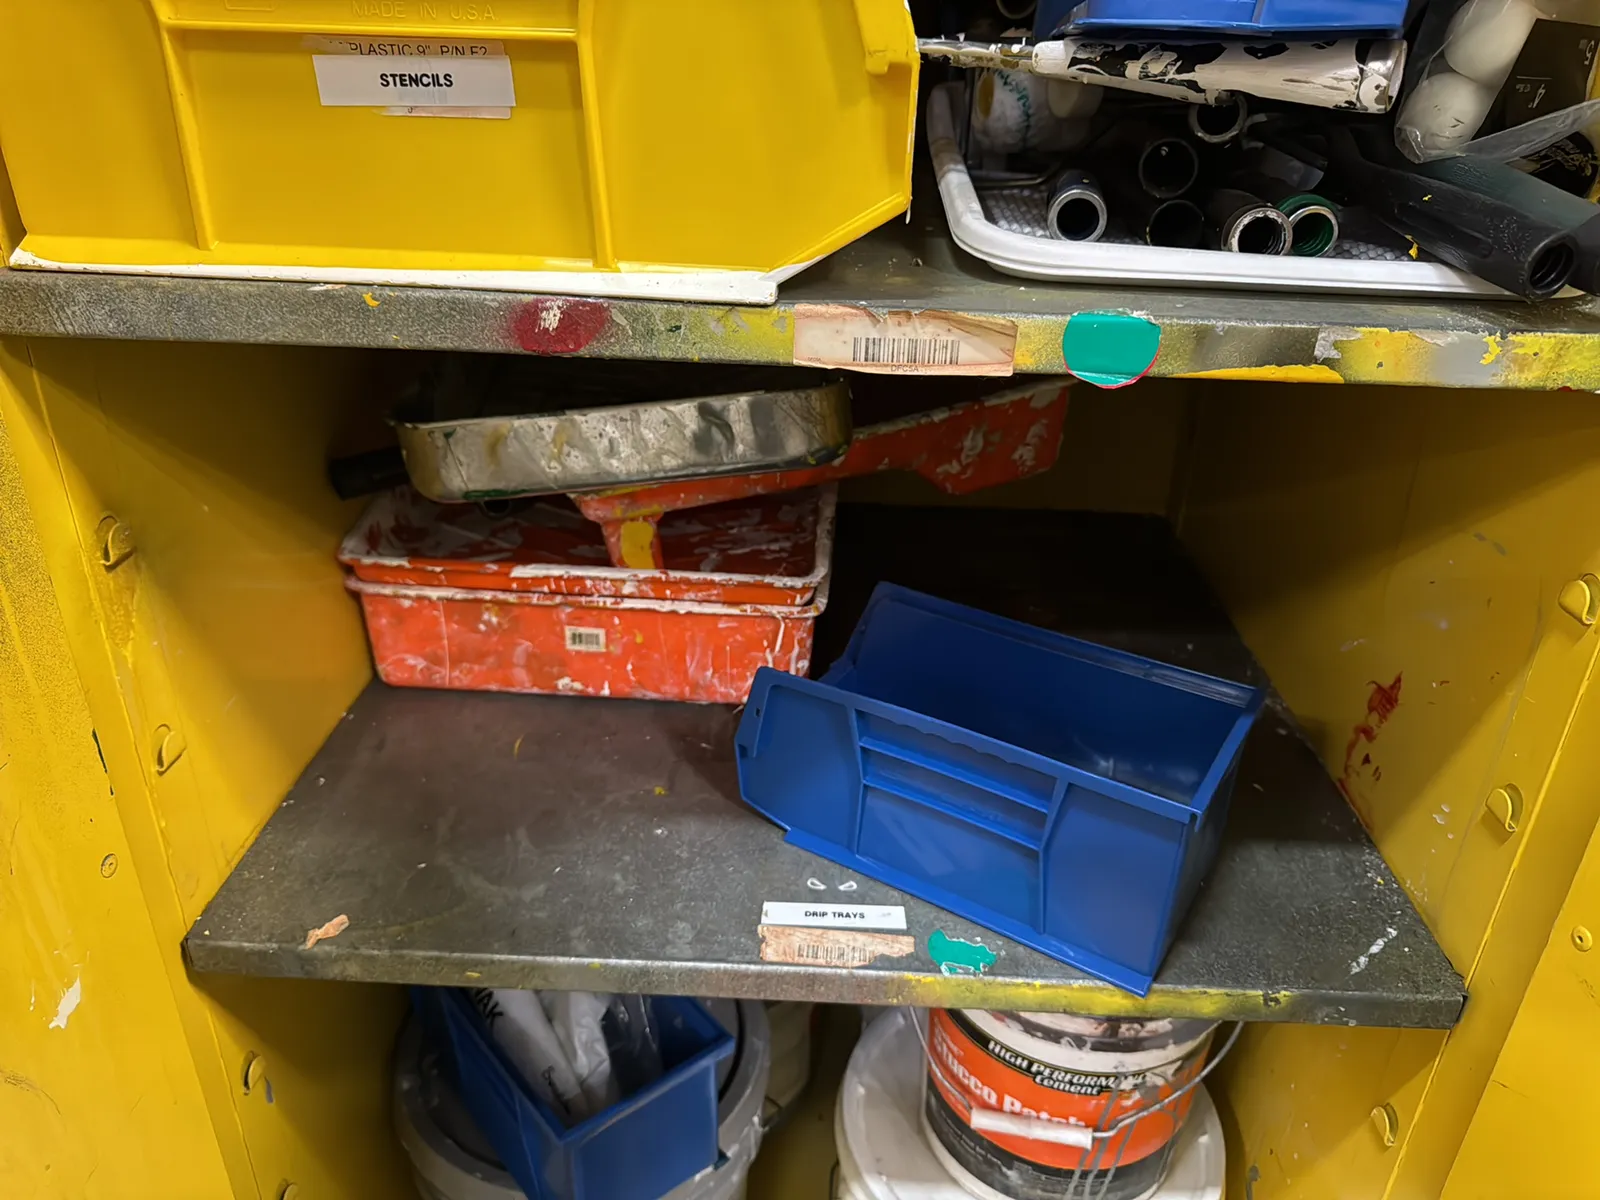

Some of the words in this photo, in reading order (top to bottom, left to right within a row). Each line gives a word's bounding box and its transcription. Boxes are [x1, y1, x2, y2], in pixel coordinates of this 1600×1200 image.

[351, 1, 406, 18] MADE
[420, 3, 437, 18] IN
[451, 5, 499, 21] U.S.A.
[380, 73, 453, 88] STENCILS
[804, 910, 828, 918] DRIP
[832, 911, 864, 919] TRAYS
[987, 1040, 1029, 1069] HIGH
